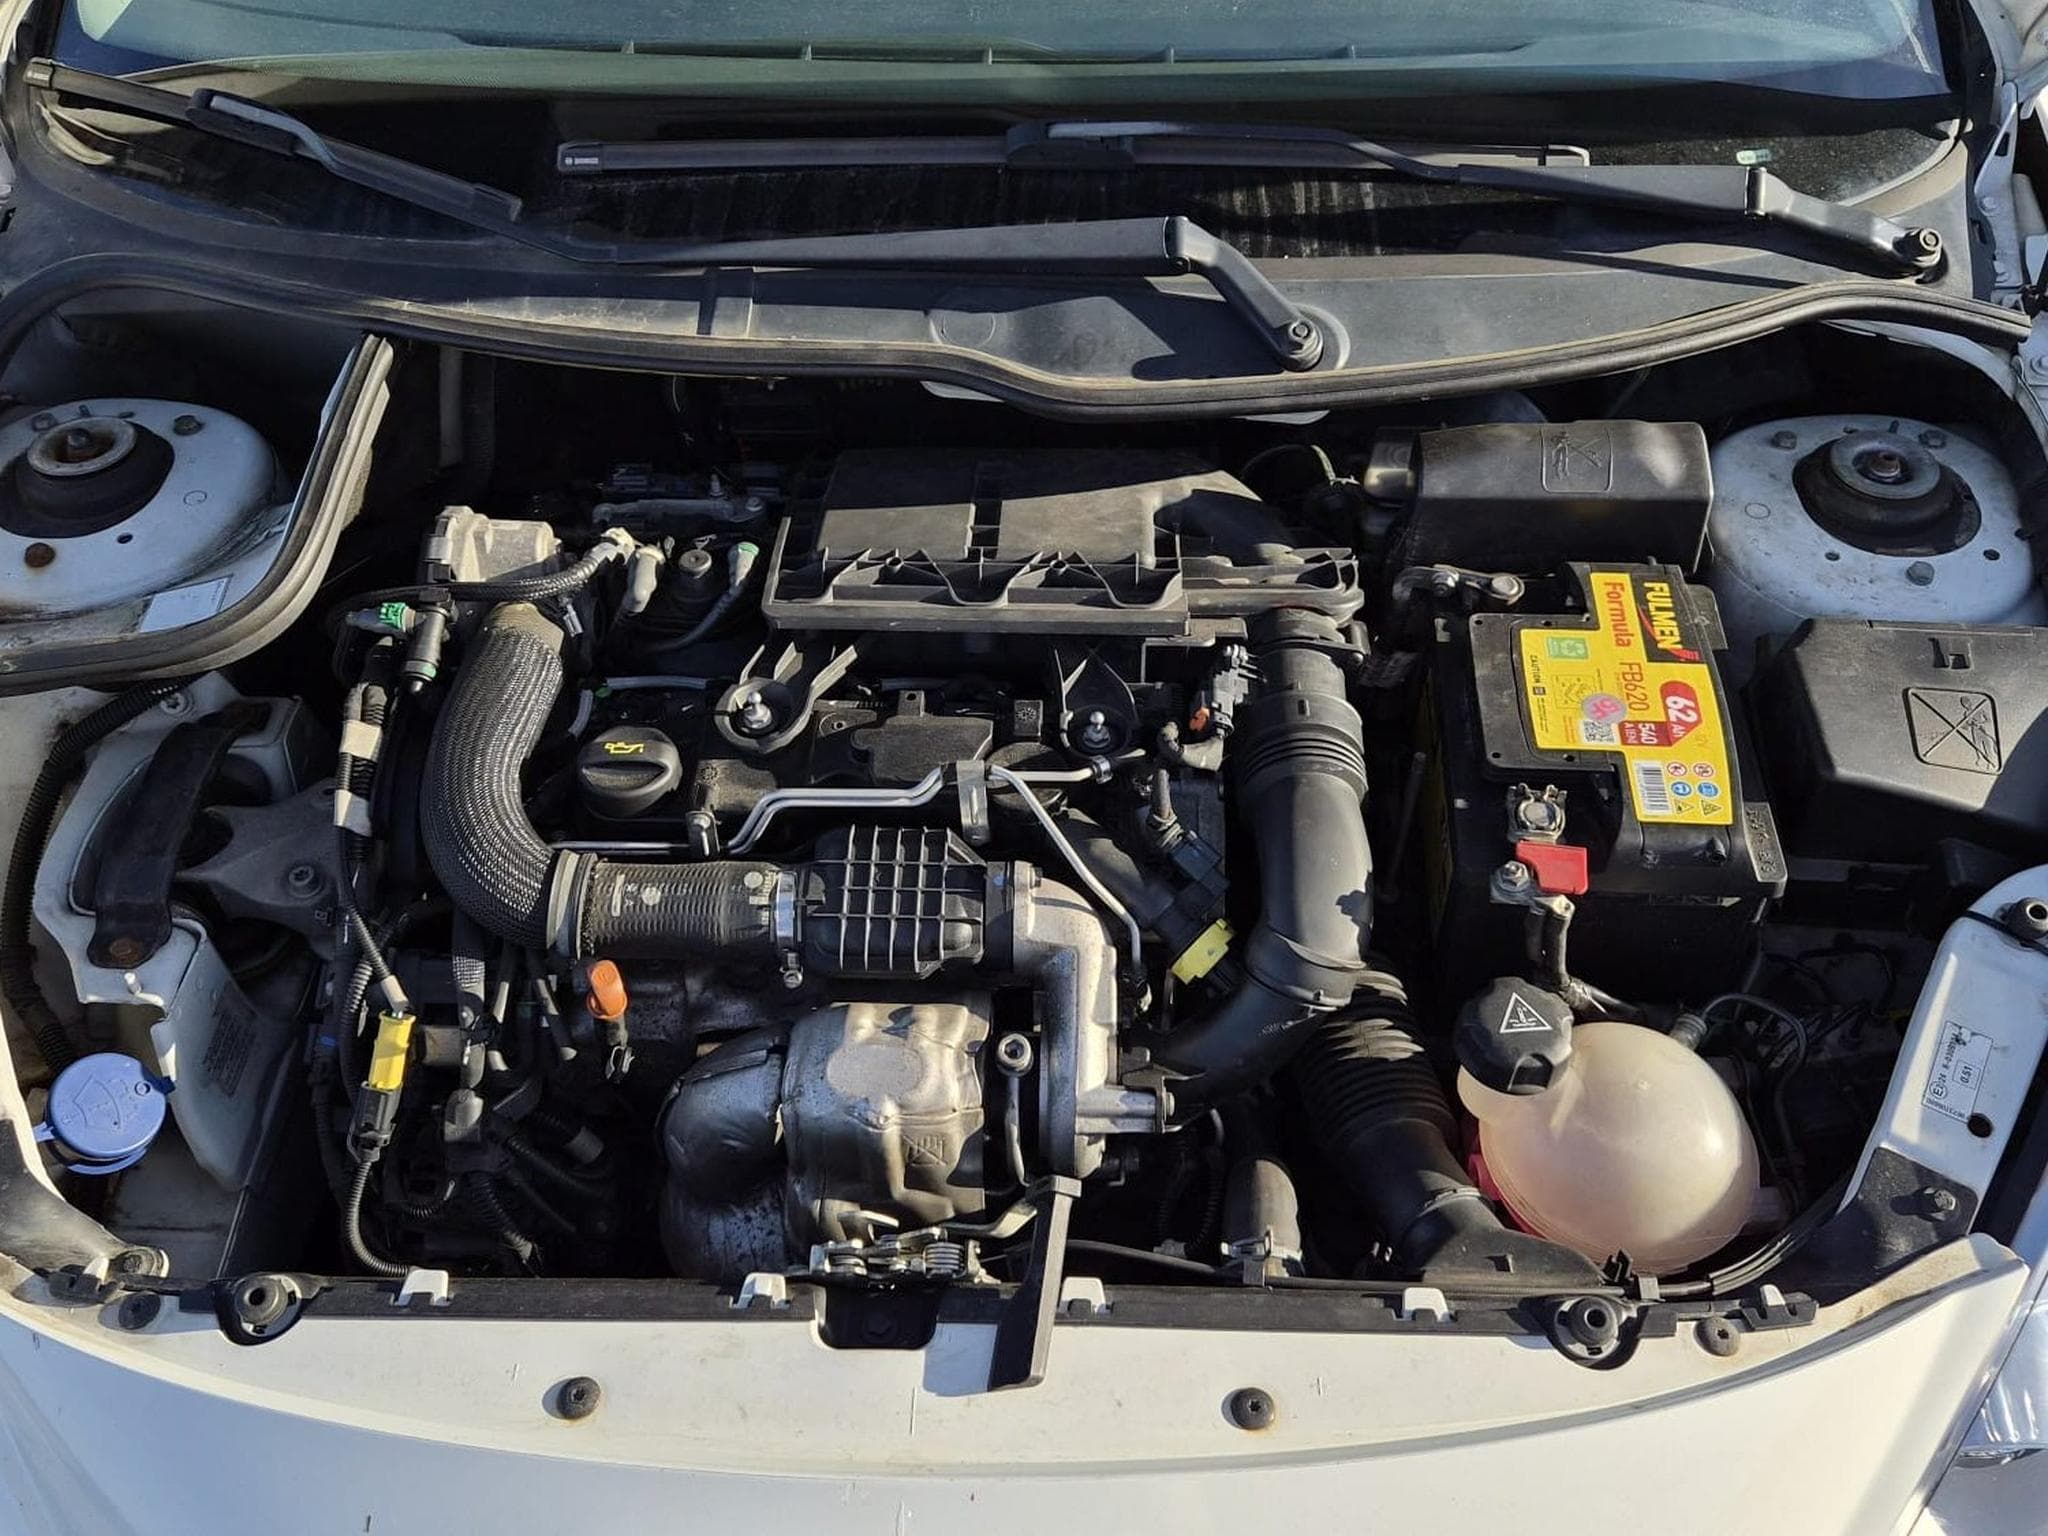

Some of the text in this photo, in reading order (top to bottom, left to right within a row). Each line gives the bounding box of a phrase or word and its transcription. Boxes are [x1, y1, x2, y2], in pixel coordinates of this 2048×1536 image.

[1604, 582, 1634, 647] Formula
[1643, 582, 1683, 649] FULMEN
[1619, 662, 1650, 711] FB620
[1638, 723, 1658, 744] 540
[1665, 696, 1698, 738] 62 Ah
